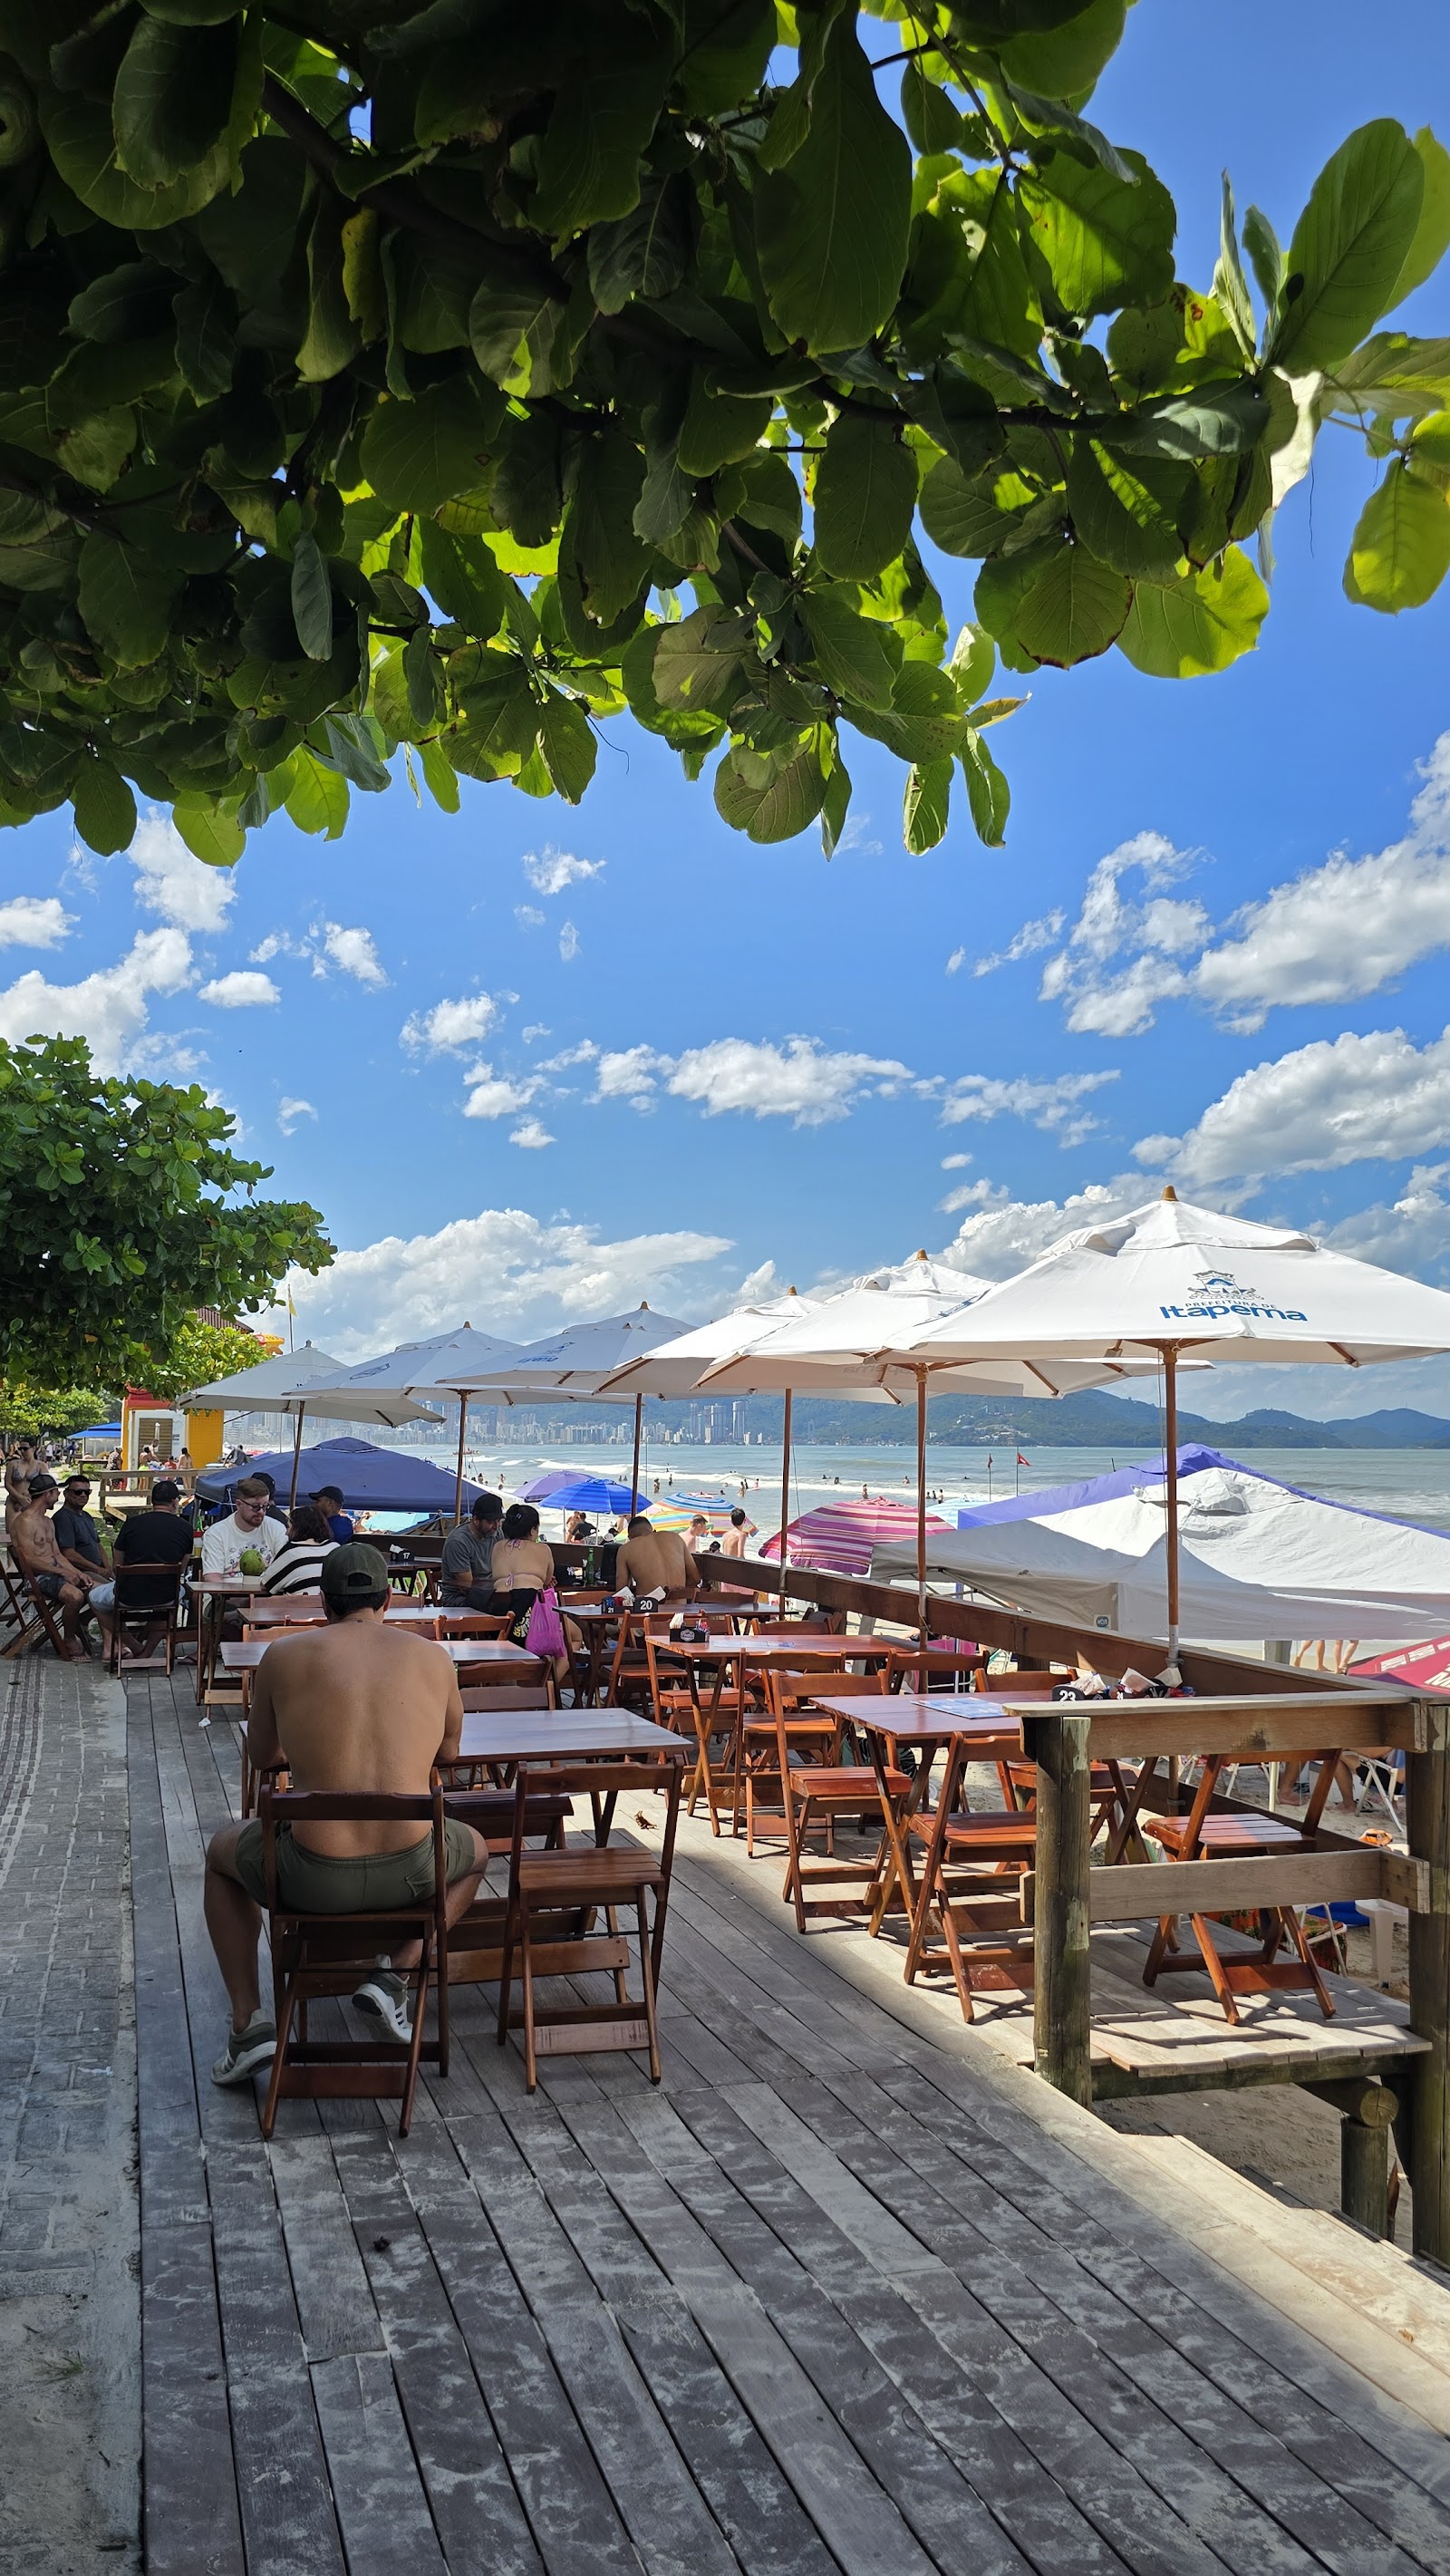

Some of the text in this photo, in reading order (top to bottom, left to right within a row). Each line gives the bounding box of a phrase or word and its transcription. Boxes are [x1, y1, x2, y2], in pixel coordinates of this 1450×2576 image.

[1184, 1299, 1258, 1308] PREFEITURA
[1159, 1304, 1308, 1322] Itapema
[402, 1552, 411, 1560] 17
[640, 1600, 652, 1611] 20
[1059, 1690, 1077, 1701] 23
